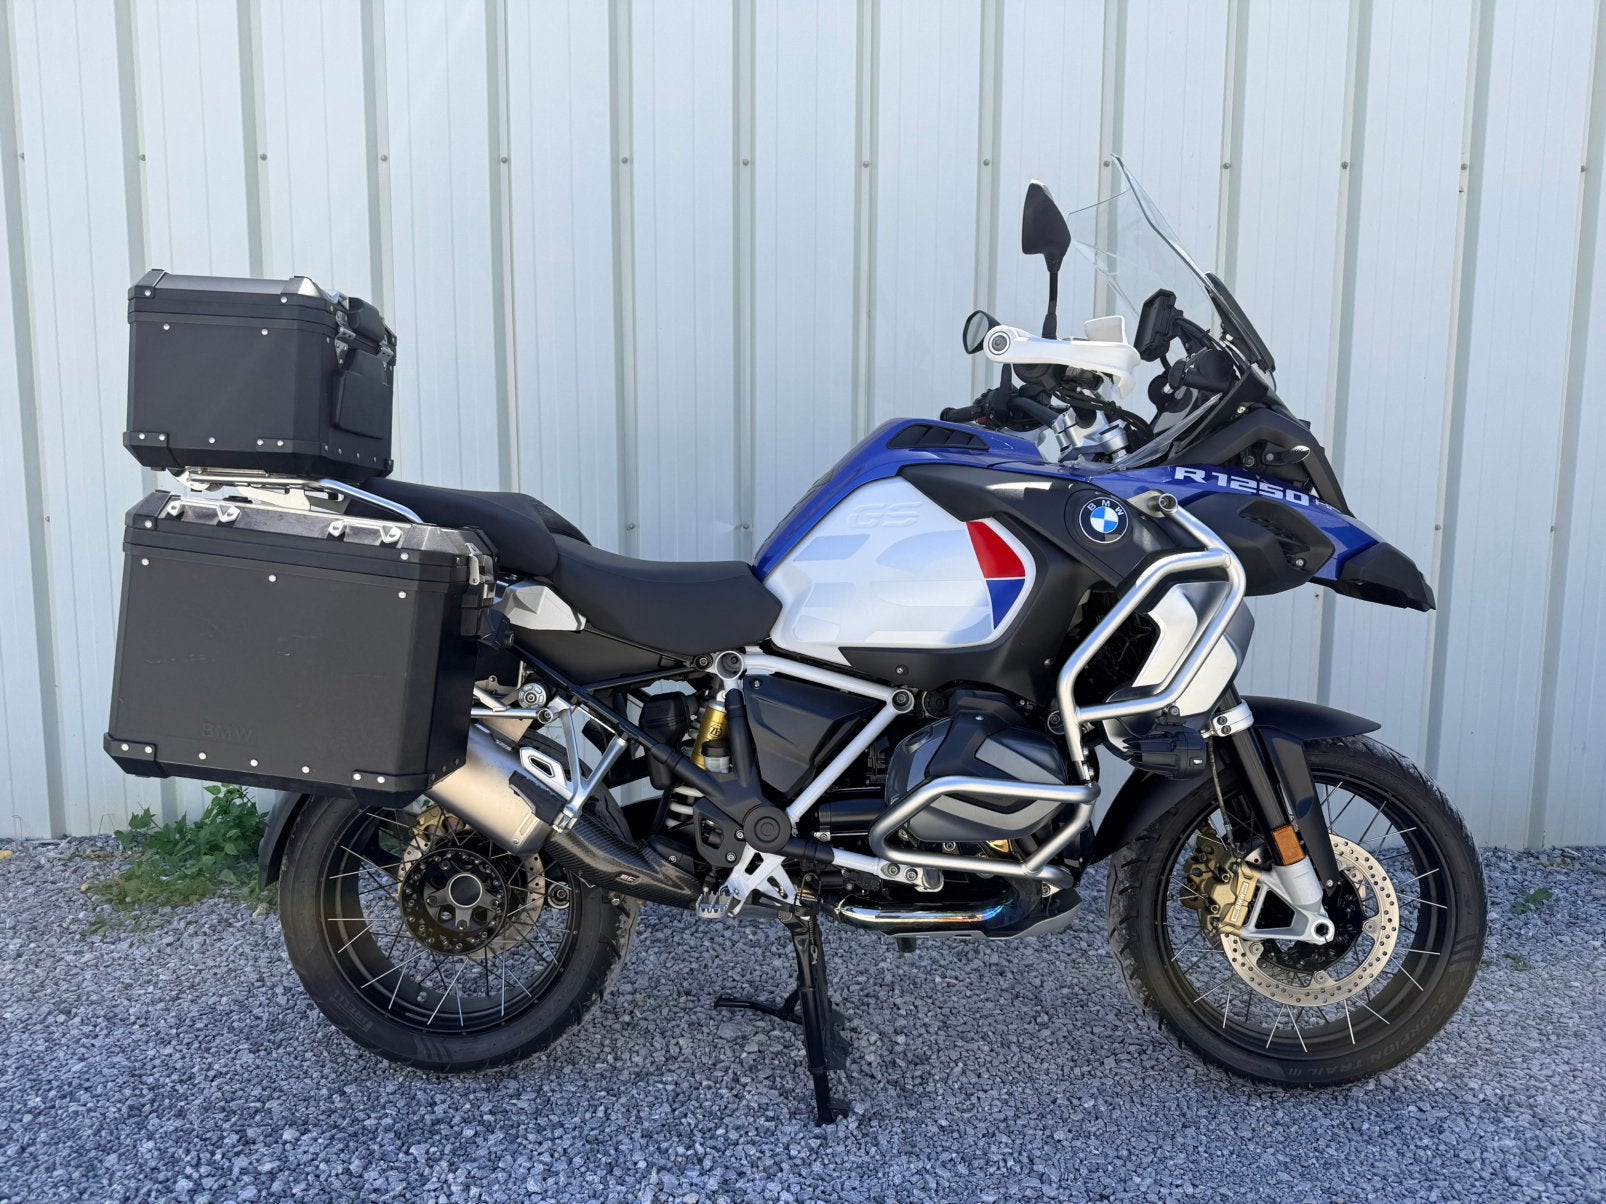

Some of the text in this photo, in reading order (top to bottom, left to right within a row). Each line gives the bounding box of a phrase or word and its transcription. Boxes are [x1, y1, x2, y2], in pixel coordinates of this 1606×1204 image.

[1174, 466, 1207, 483] R
[1211, 472, 1310, 506] 1250
[847, 501, 923, 529] GS
[1087, 500, 1124, 516] BMW
[203, 721, 254, 742] BMW
[1370, 993, 1447, 1063] SCORPION
[1309, 1060, 1363, 1076] TRAIL
